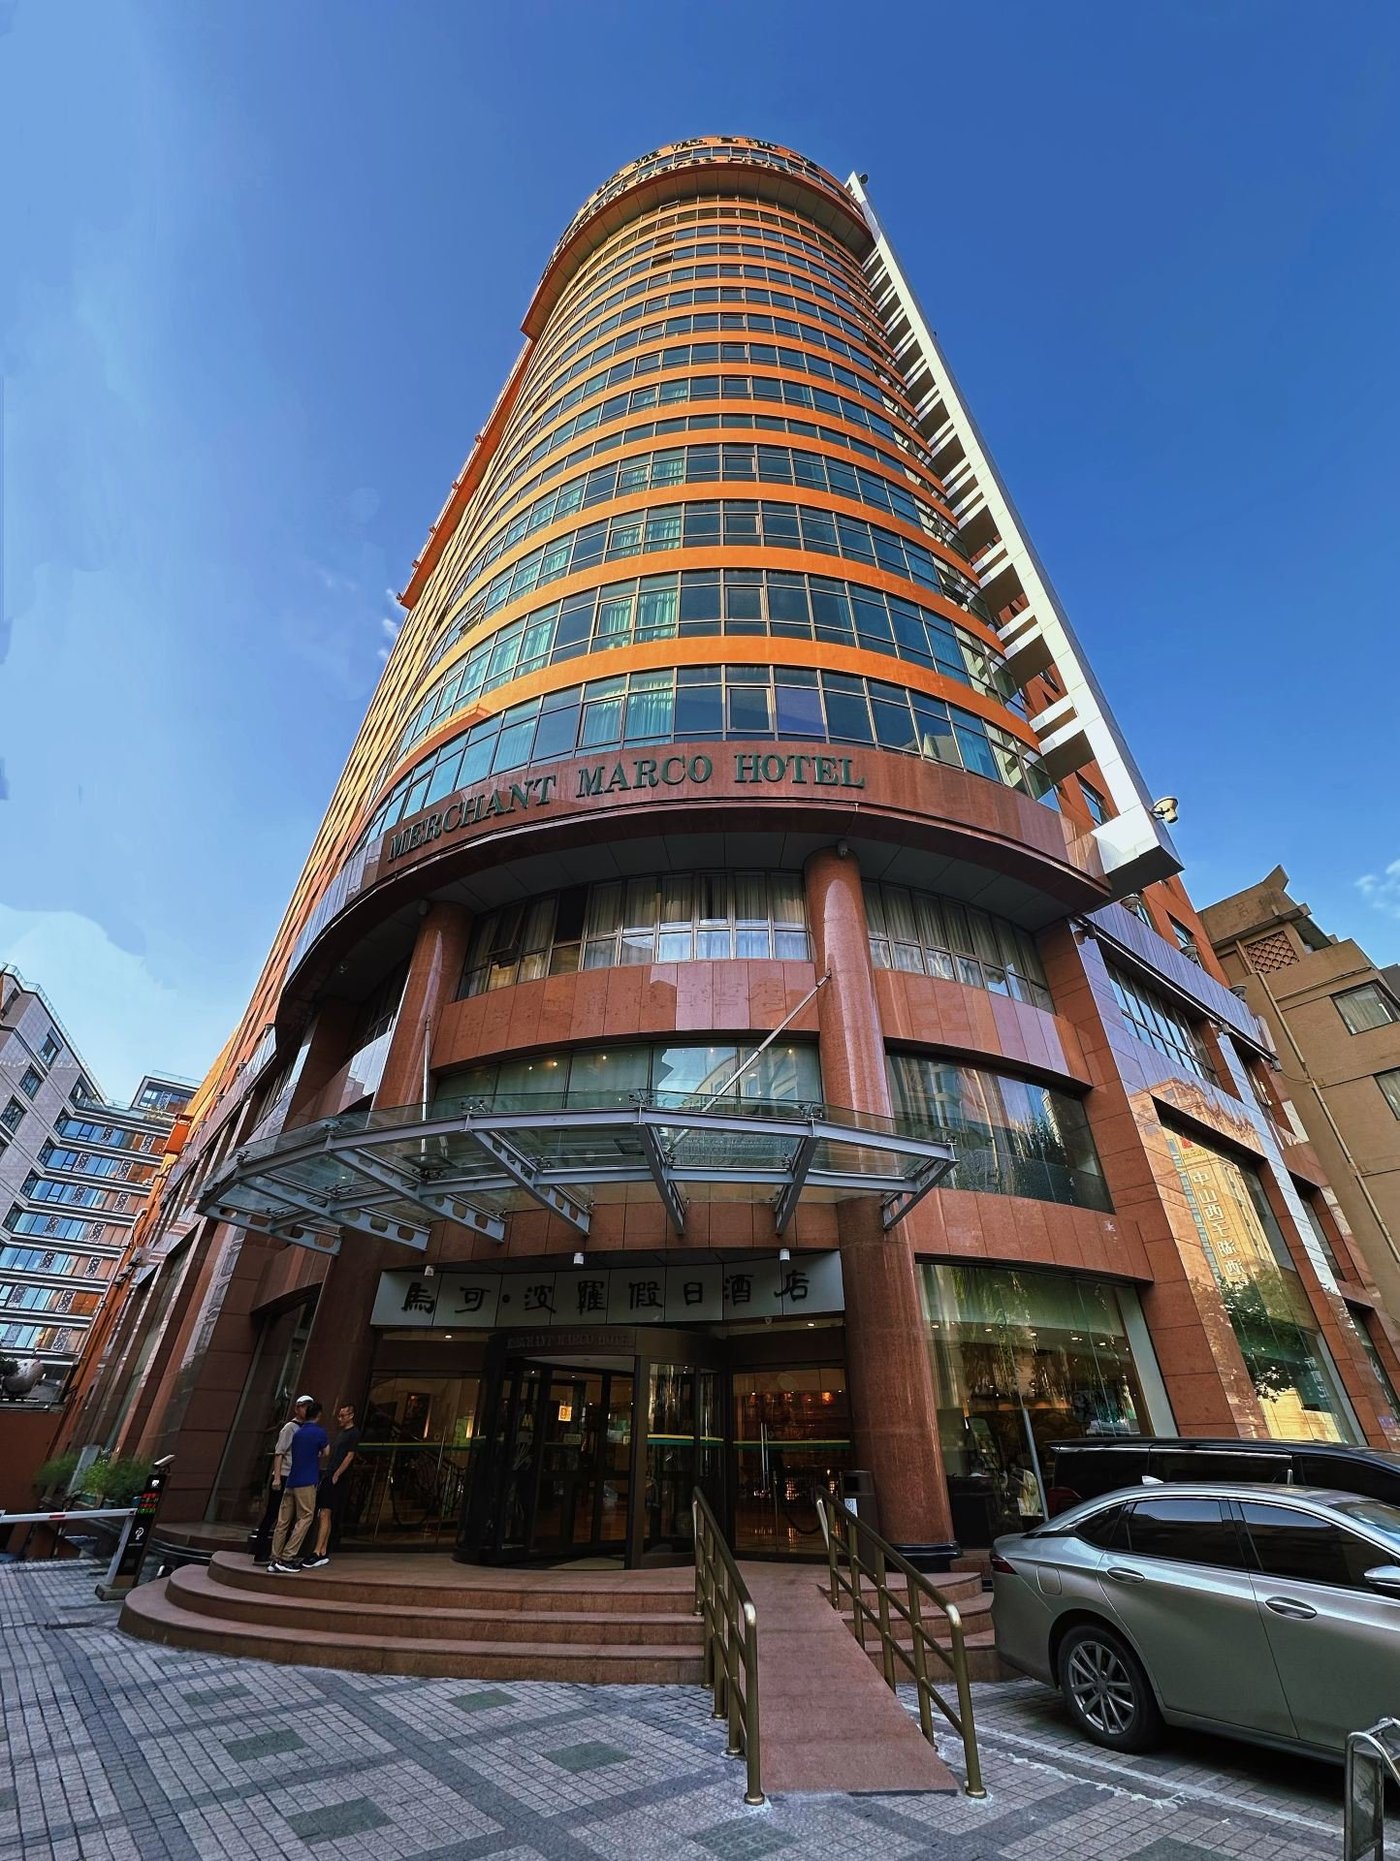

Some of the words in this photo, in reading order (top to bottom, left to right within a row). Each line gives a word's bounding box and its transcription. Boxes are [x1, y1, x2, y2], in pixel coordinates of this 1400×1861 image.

[387, 774, 557, 863] MERCHANT
[576, 755, 713, 798] MARCO
[733, 753, 866, 788] HOTEL
